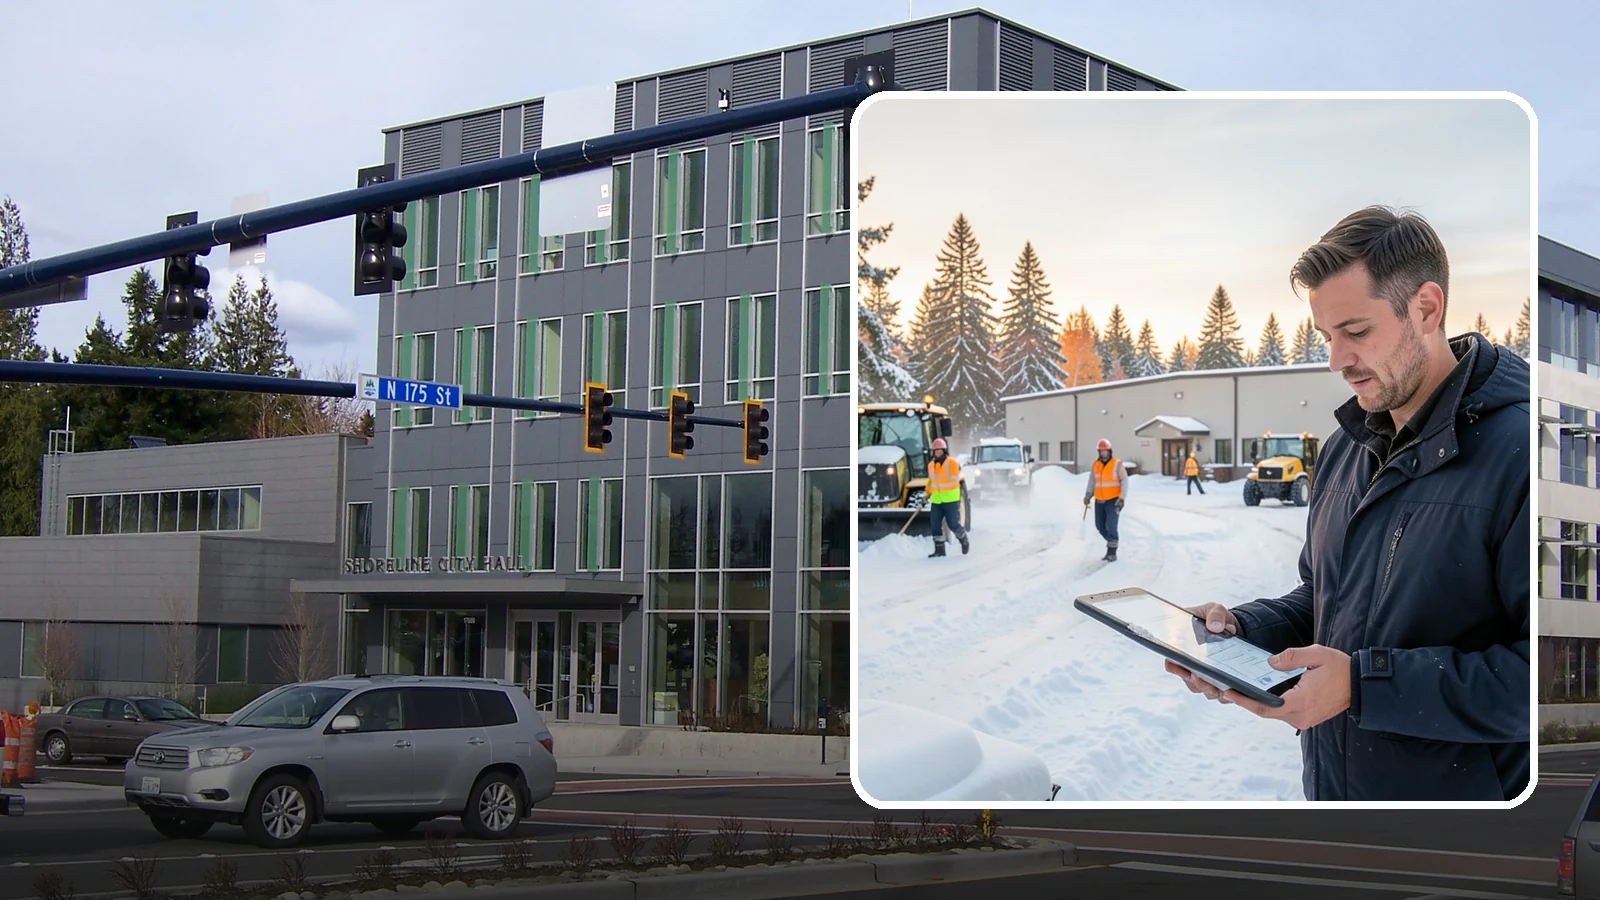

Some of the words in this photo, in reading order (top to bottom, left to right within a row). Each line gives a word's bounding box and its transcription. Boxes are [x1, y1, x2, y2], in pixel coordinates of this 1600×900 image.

[387, 380, 396, 400] N
[405, 382, 428, 403] 175
[436, 386, 452, 406] St
[343, 557, 432, 574] SHORELINE
[438, 556, 475, 573] CITY
[483, 555, 525, 572] HALL
